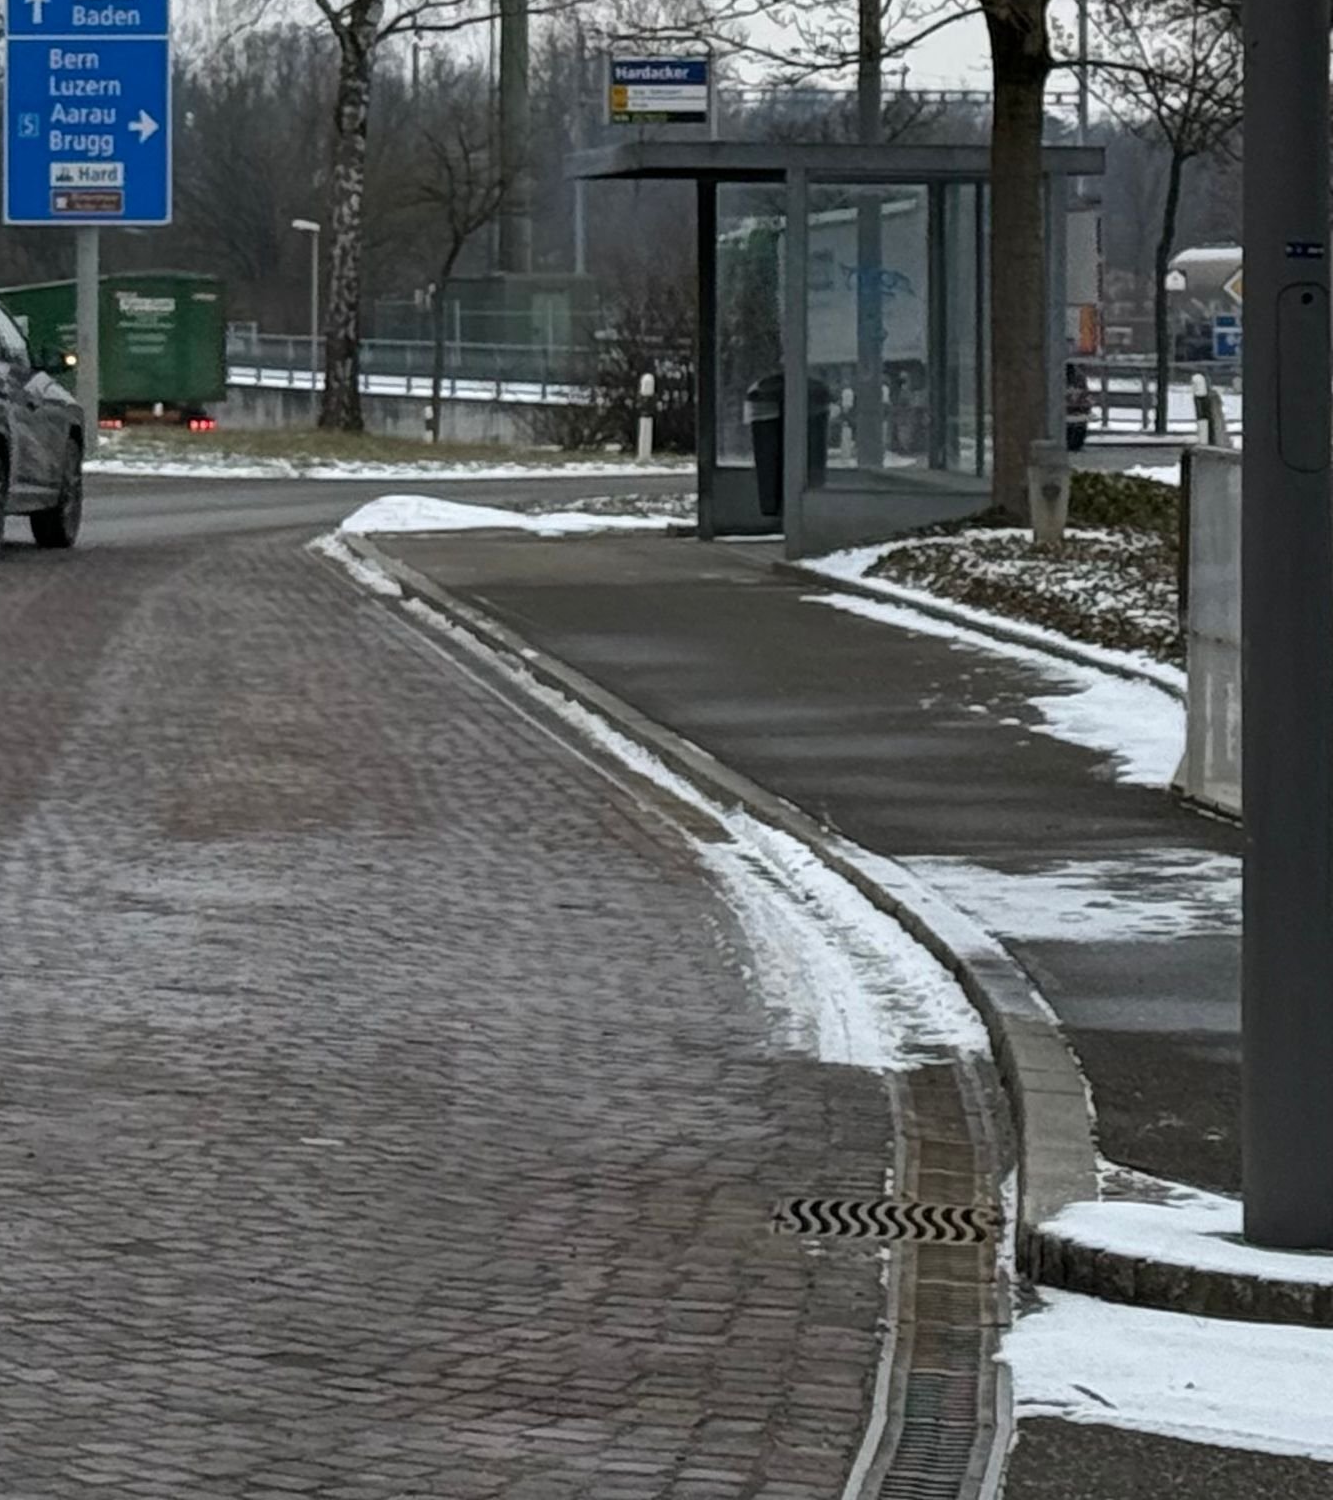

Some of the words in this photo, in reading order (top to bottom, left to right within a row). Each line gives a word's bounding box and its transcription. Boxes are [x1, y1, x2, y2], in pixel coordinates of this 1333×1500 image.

[72, 5, 141, 26] Baden
[49, 48, 99, 70] Bern
[615, 66, 689, 80] Hardacker
[49, 76, 121, 97] Luzern
[50, 103, 116, 125] Aarau
[49, 130, 115, 157] Brugg
[78, 166, 118, 182] Hard
